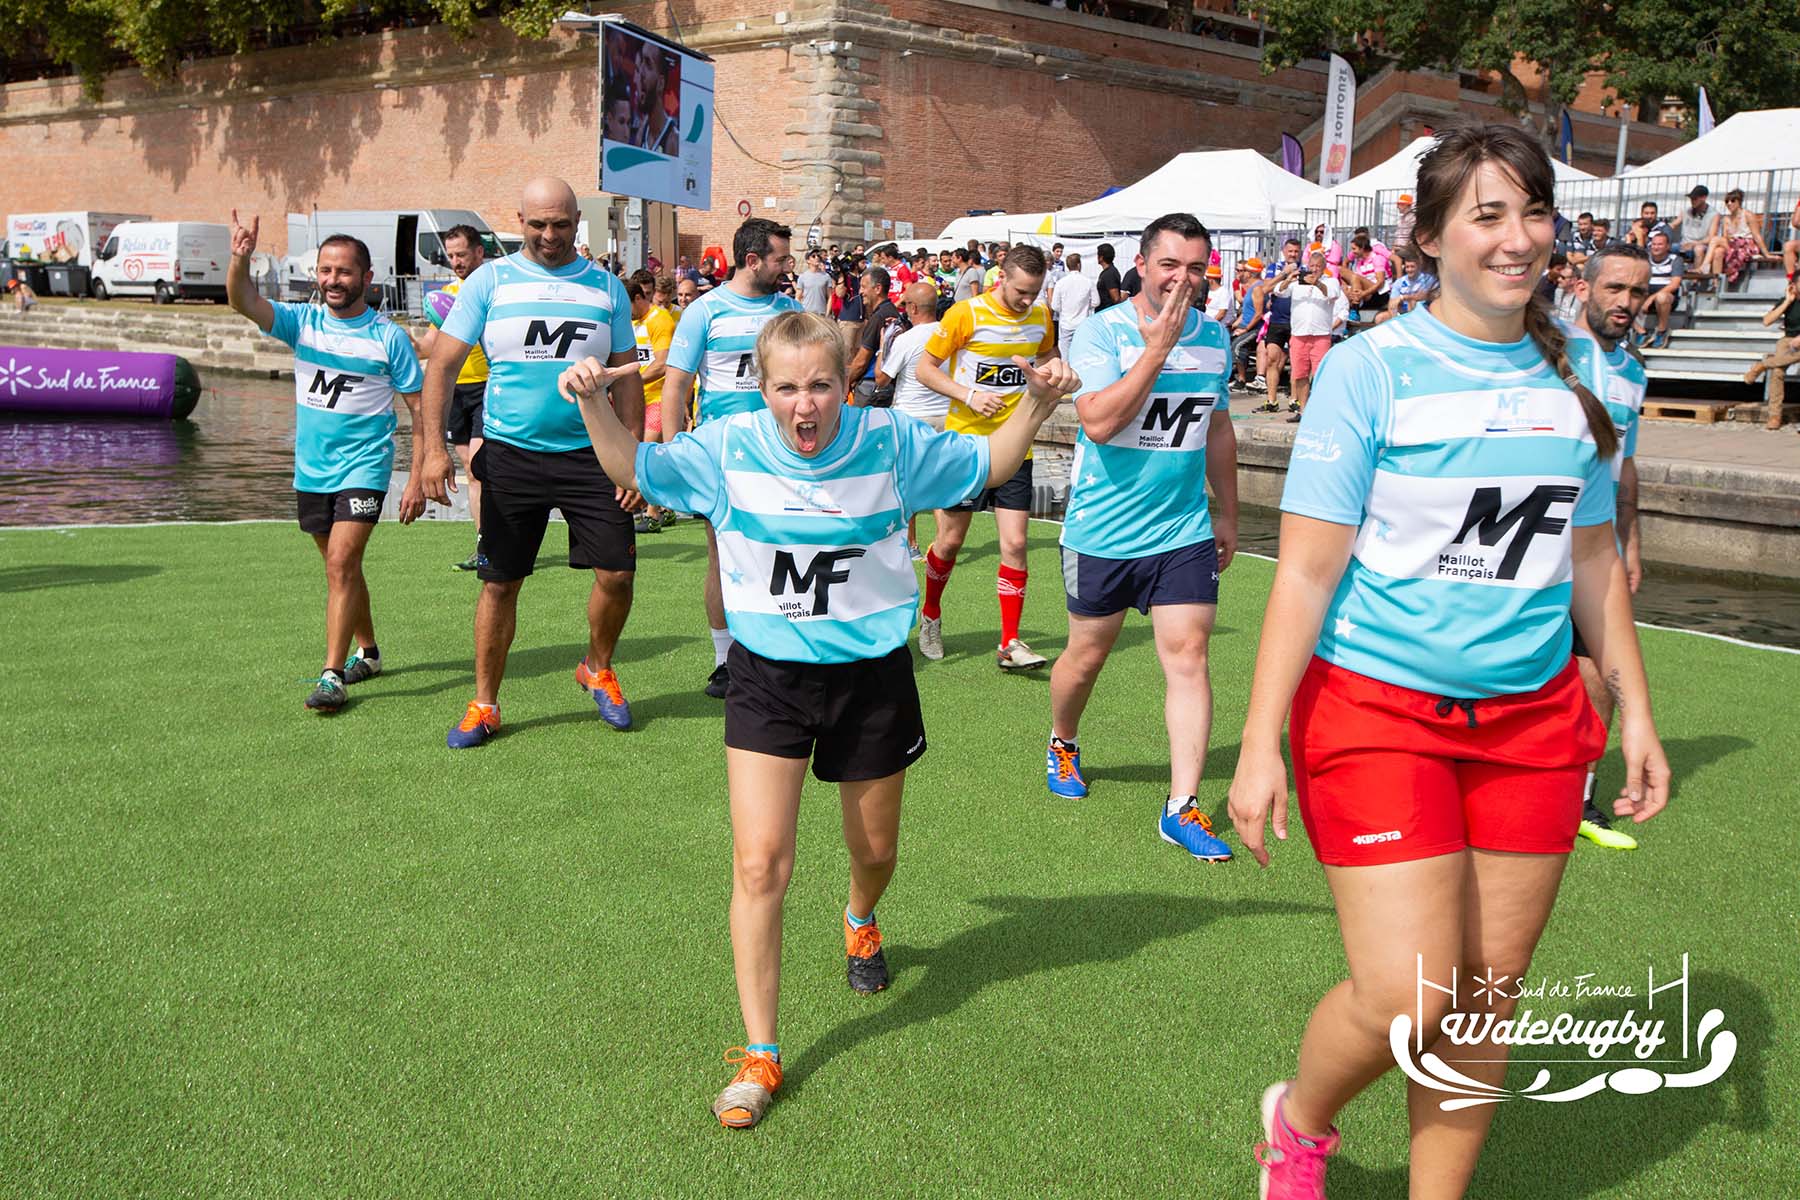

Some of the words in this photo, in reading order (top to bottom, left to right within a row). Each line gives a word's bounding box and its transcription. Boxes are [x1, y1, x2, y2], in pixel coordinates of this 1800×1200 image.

[524, 320, 597, 359] MF
[34, 368, 71, 392] Sud
[73, 372, 97, 389] de
[97, 366, 160, 392] France
[308, 369, 365, 409] MF
[1141, 397, 1215, 448] MF
[1450, 485, 1581, 580] MF
[1438, 565, 1494, 579] Français
[1439, 554, 1485, 567] Maillot
[769, 548, 867, 616] MF
[779, 601, 802, 611] illot
